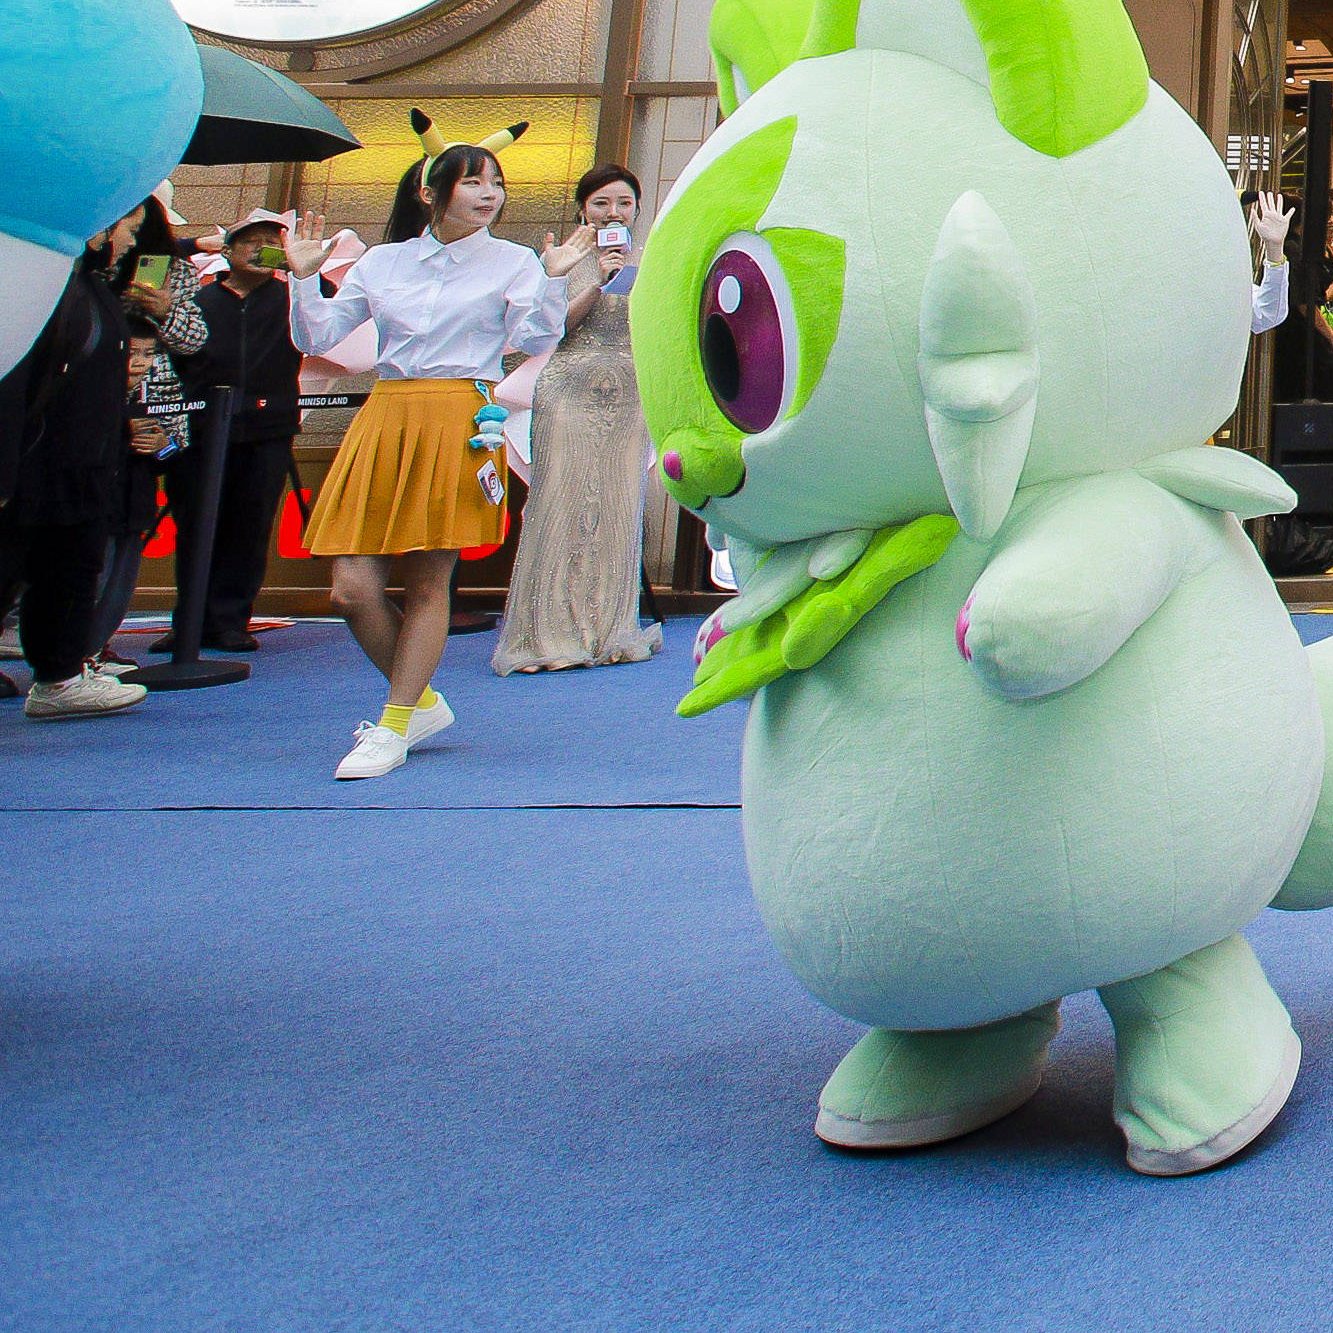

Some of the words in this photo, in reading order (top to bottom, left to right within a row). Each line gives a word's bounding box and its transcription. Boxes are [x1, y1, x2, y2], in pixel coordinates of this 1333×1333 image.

[147, 403, 180, 414] MINISO
[182, 400, 206, 411] LAND
[298, 397, 326, 406] MINISO
[327, 396, 348, 405] LAND
